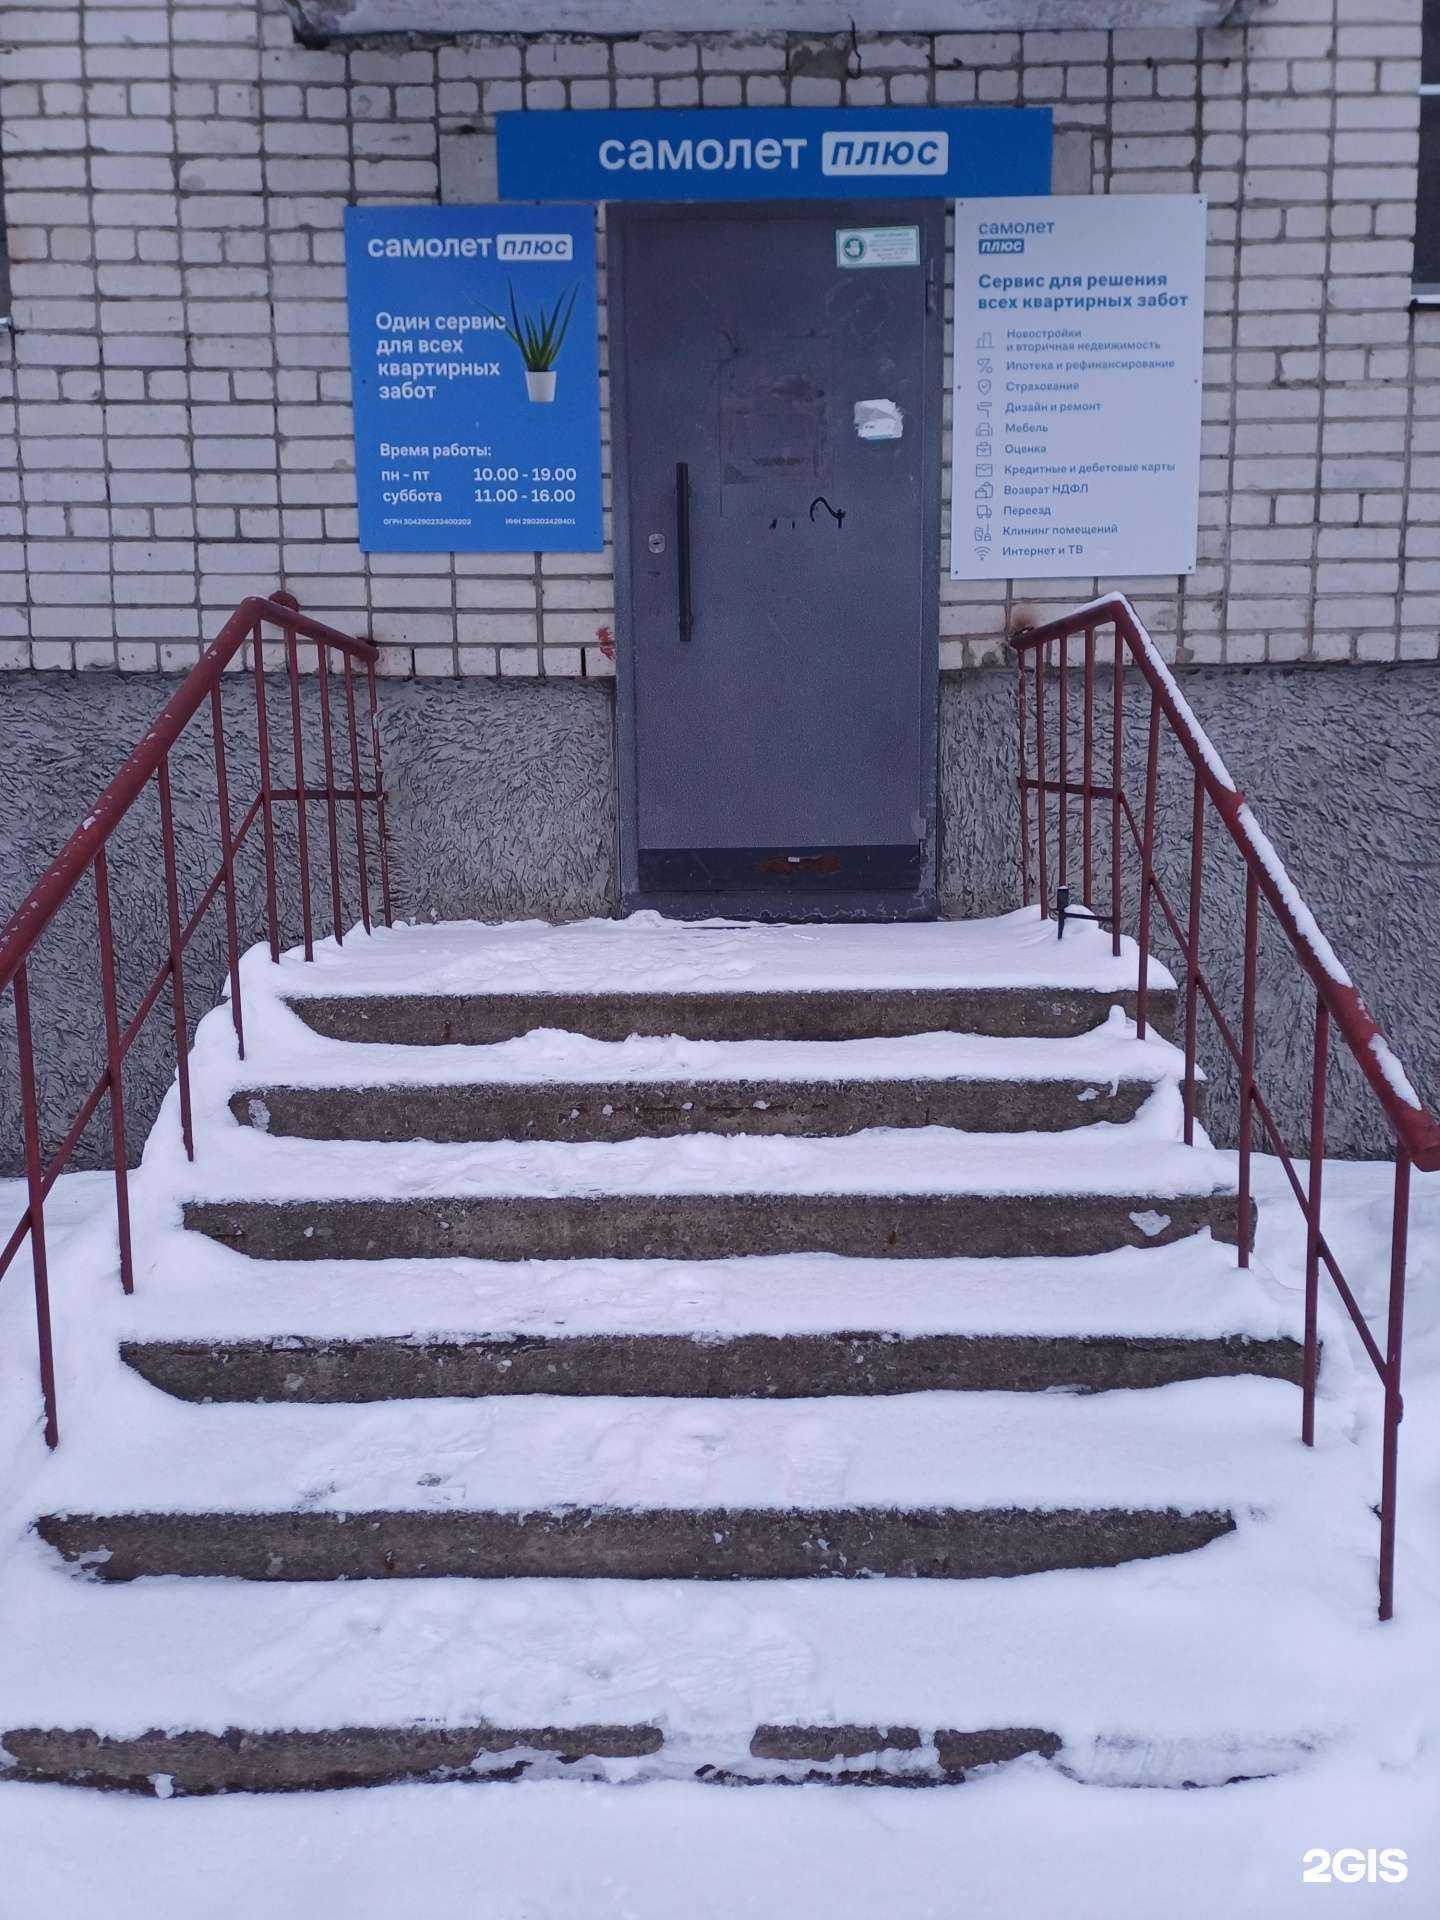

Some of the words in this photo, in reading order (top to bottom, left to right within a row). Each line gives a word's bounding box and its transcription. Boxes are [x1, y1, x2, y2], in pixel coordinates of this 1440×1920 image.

[600, 137, 807, 170] самолет
[978, 222, 1055, 235] самолет
[367, 237, 492, 258] самолет
[978, 274, 1045, 291] Сервис
[1049, 275, 1082, 289] для
[1087, 274, 1168, 289] решения
[978, 297, 1018, 310] всех
[1023, 294, 1132, 311] квартирных
[1137, 292, 1188, 307] забот
[375, 311, 430, 332] Один
[435, 315, 506, 333] сервис
[1007, 329, 1082, 340] Новостройки
[376, 339, 413, 355] для
[418, 338, 464, 352] всех
[1006, 344, 1014, 352] и
[1016, 343, 1075, 354] вторичная
[1077, 341, 1161, 351] недвижимость
[378, 361, 501, 380] квартирных
[1006, 360, 1054, 370] Ипотека
[1057, 361, 1063, 369] и
[1065, 358, 1175, 370] рефинансирование
[379, 382, 437, 400] забот
[1006, 381, 1080, 393] Страхование
[1005, 402, 1047, 414] Дизайн
[1050, 403, 1057, 411] и
[1060, 402, 1101, 413] ремонт
[1005, 423, 1048, 433] Мебель
[380, 443, 429, 458] Время
[433, 442, 492, 459] работы:
[1004, 443, 1047, 454] Оценка
[381, 469, 400, 480] пн
[413, 469, 430, 480] пт
[473, 468, 519, 480] 10.00
[532, 468, 577, 480] 19.00
[1004, 464, 1066, 475] Кредитные
[1069, 464, 1076, 472] и
[1078, 462, 1139, 473] дебетовые
[1141, 462, 1176, 473] карты
[1003, 484, 1049, 496] Возврат
[1052, 483, 1089, 495] НДФЛ
[383, 489, 442, 504] суббота
[474, 489, 518, 501] 11.00
[531, 489, 576, 501] 16.00
[1003, 505, 1051, 517] Переезд
[1002, 526, 1050, 537] Клининг
[1053, 523, 1118, 535] помещений
[1002, 546, 1056, 557] Интернет
[1059, 547, 1065, 555] и
[1068, 545, 1084, 554] ТВ
